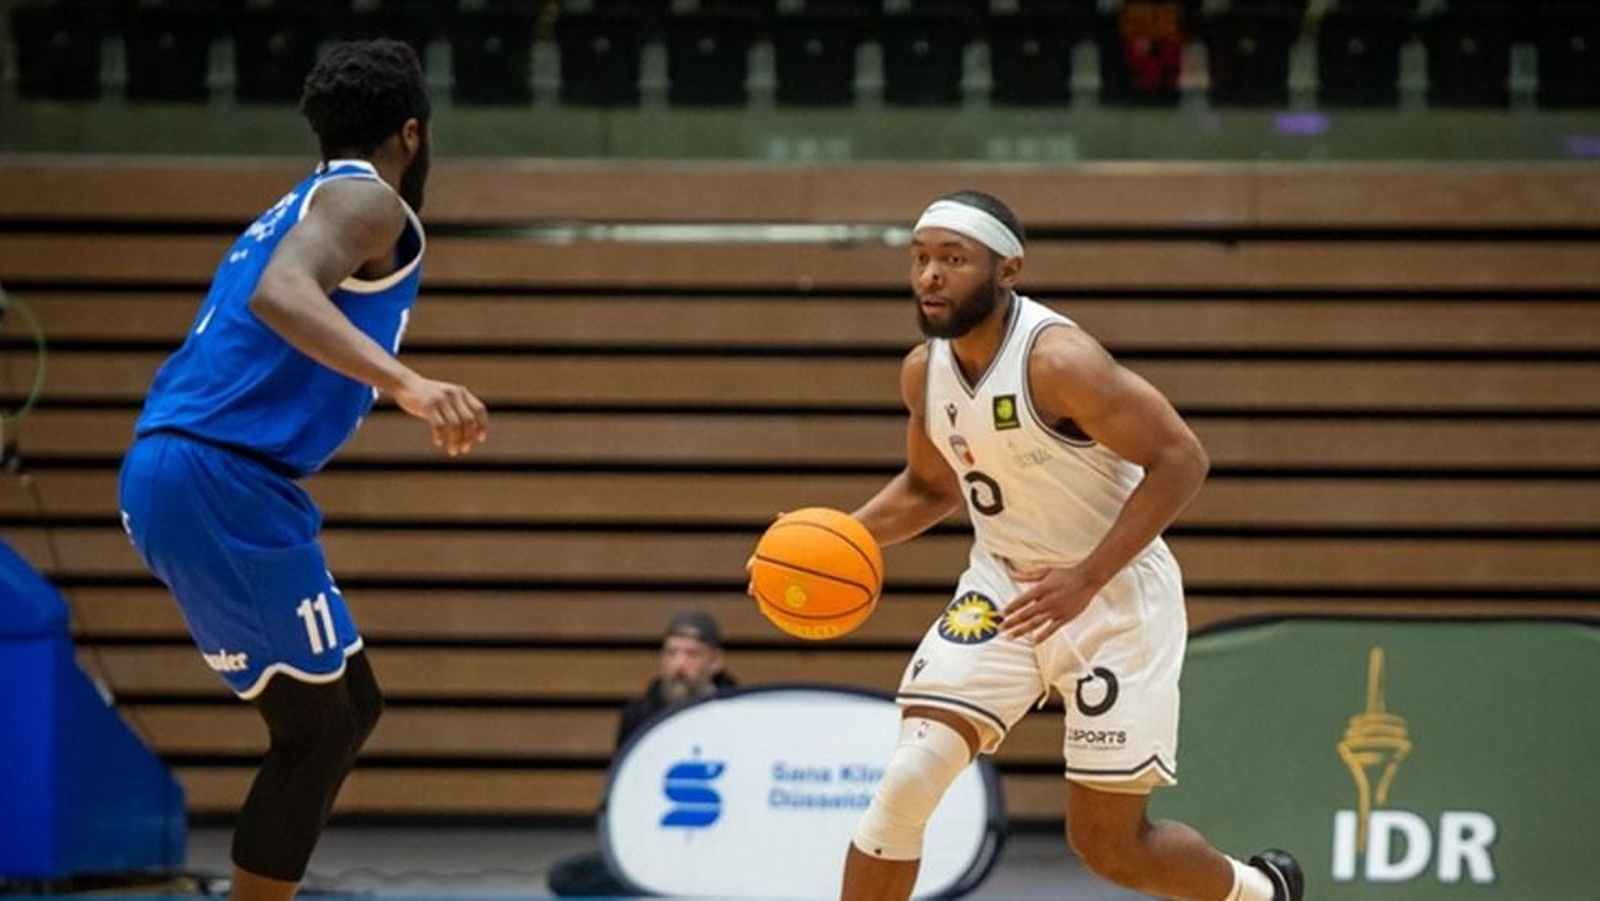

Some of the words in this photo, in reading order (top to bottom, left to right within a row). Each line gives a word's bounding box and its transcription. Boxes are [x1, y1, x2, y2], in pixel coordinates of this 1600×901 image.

[296, 592, 338, 654] 11
[771, 761, 830, 782] Sana
[1332, 809, 1497, 884] IDR
